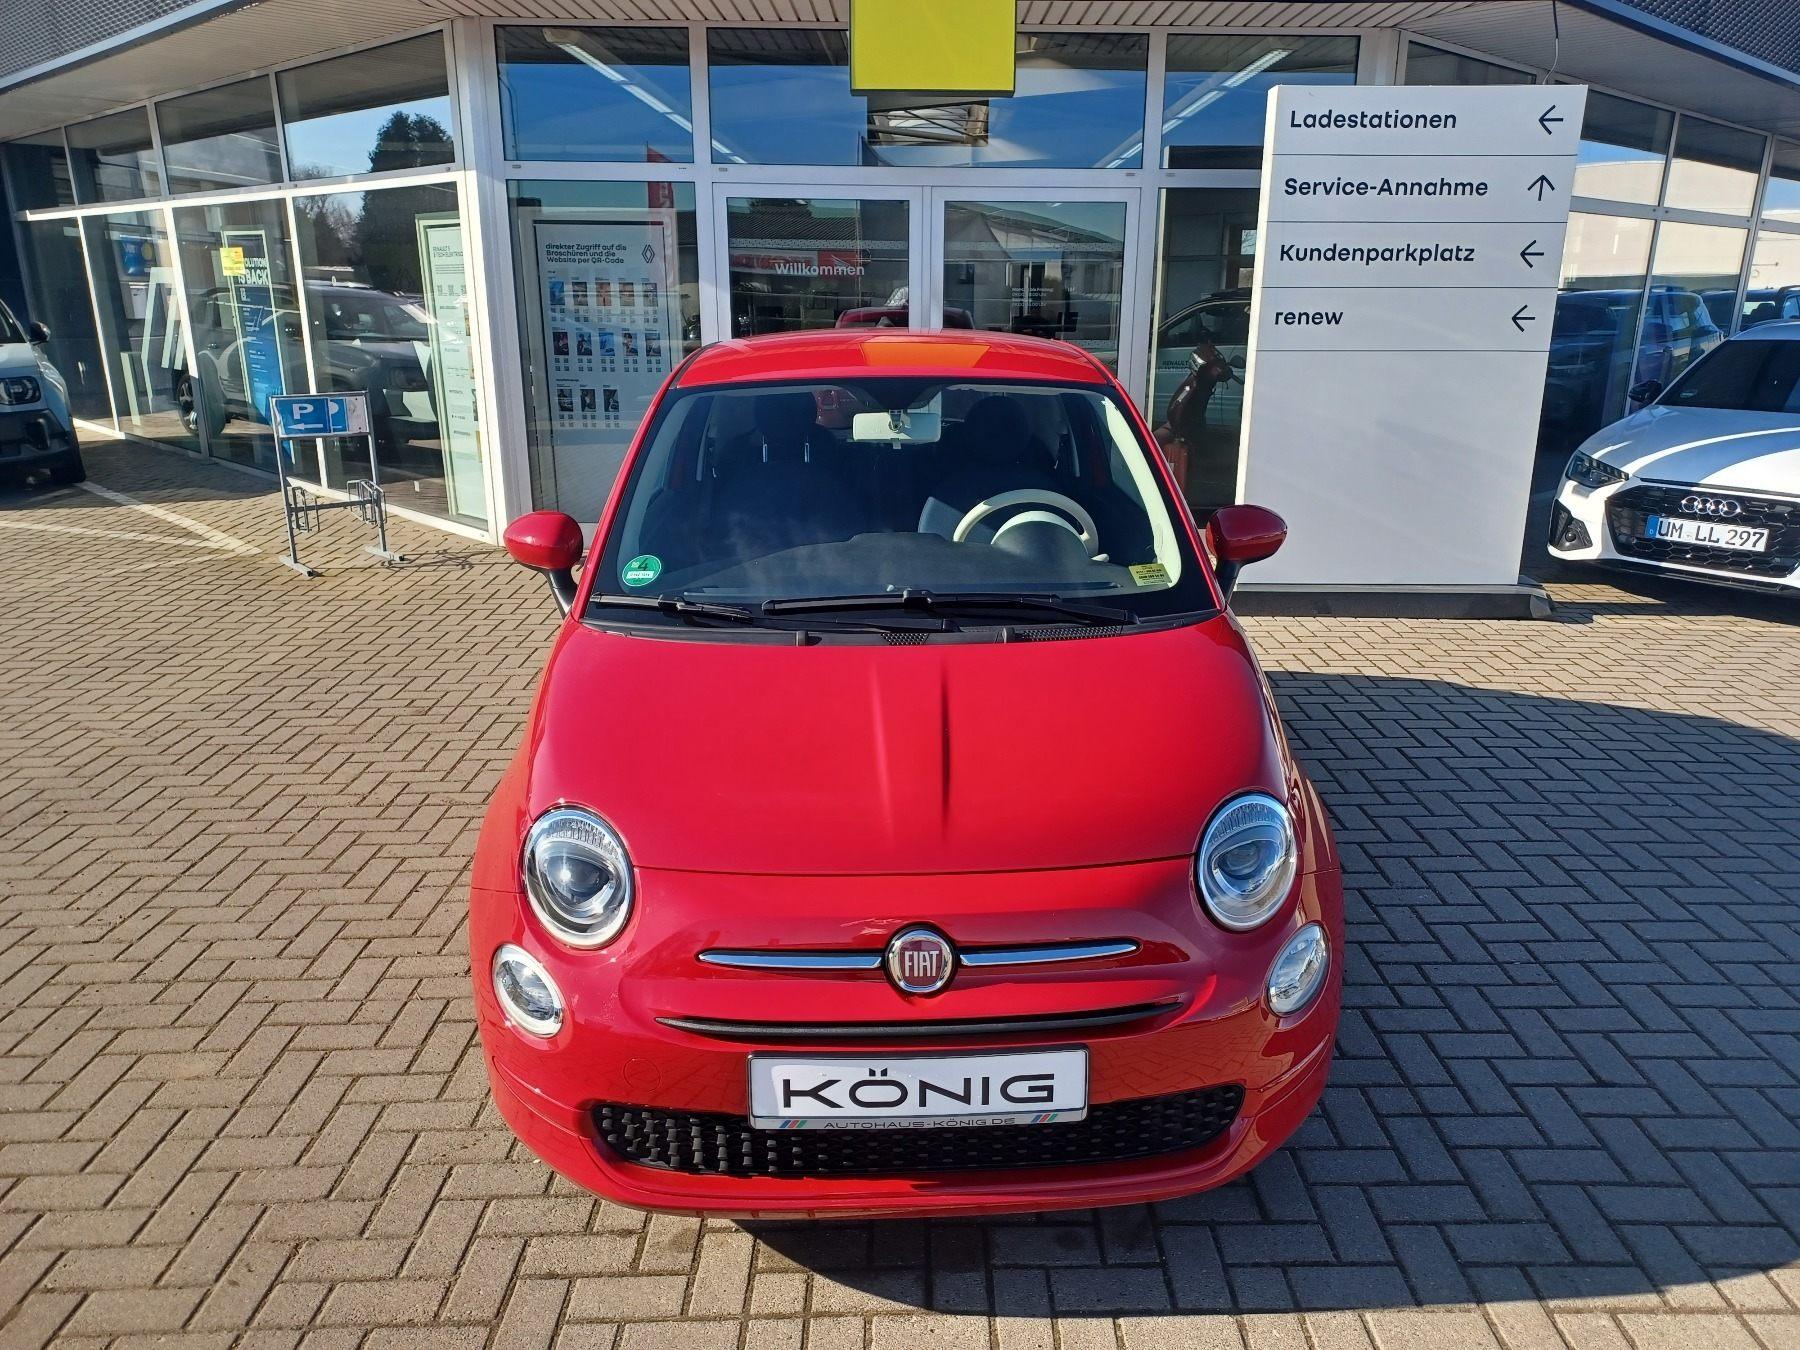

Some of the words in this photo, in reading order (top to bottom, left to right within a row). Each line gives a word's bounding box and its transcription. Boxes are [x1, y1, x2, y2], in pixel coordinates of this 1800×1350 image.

[1290, 108, 1457, 129] Ladestationen
[1284, 177, 1488, 196] Service-Annahme
[575, 244, 601, 252] Zugriff
[1279, 243, 1475, 266] Kundenparkplatz
[774, 261, 865, 276] Willkommen
[1274, 311, 1344, 326] renew
[292, 403, 314, 420] P
[1657, 520, 1684, 539] UM
[1694, 525, 1720, 544] LL
[1724, 529, 1765, 548] 297
[637, 557, 649, 571] 4
[904, 950, 940, 977] FIAT
[782, 1067, 1055, 1109] KÖNIG
